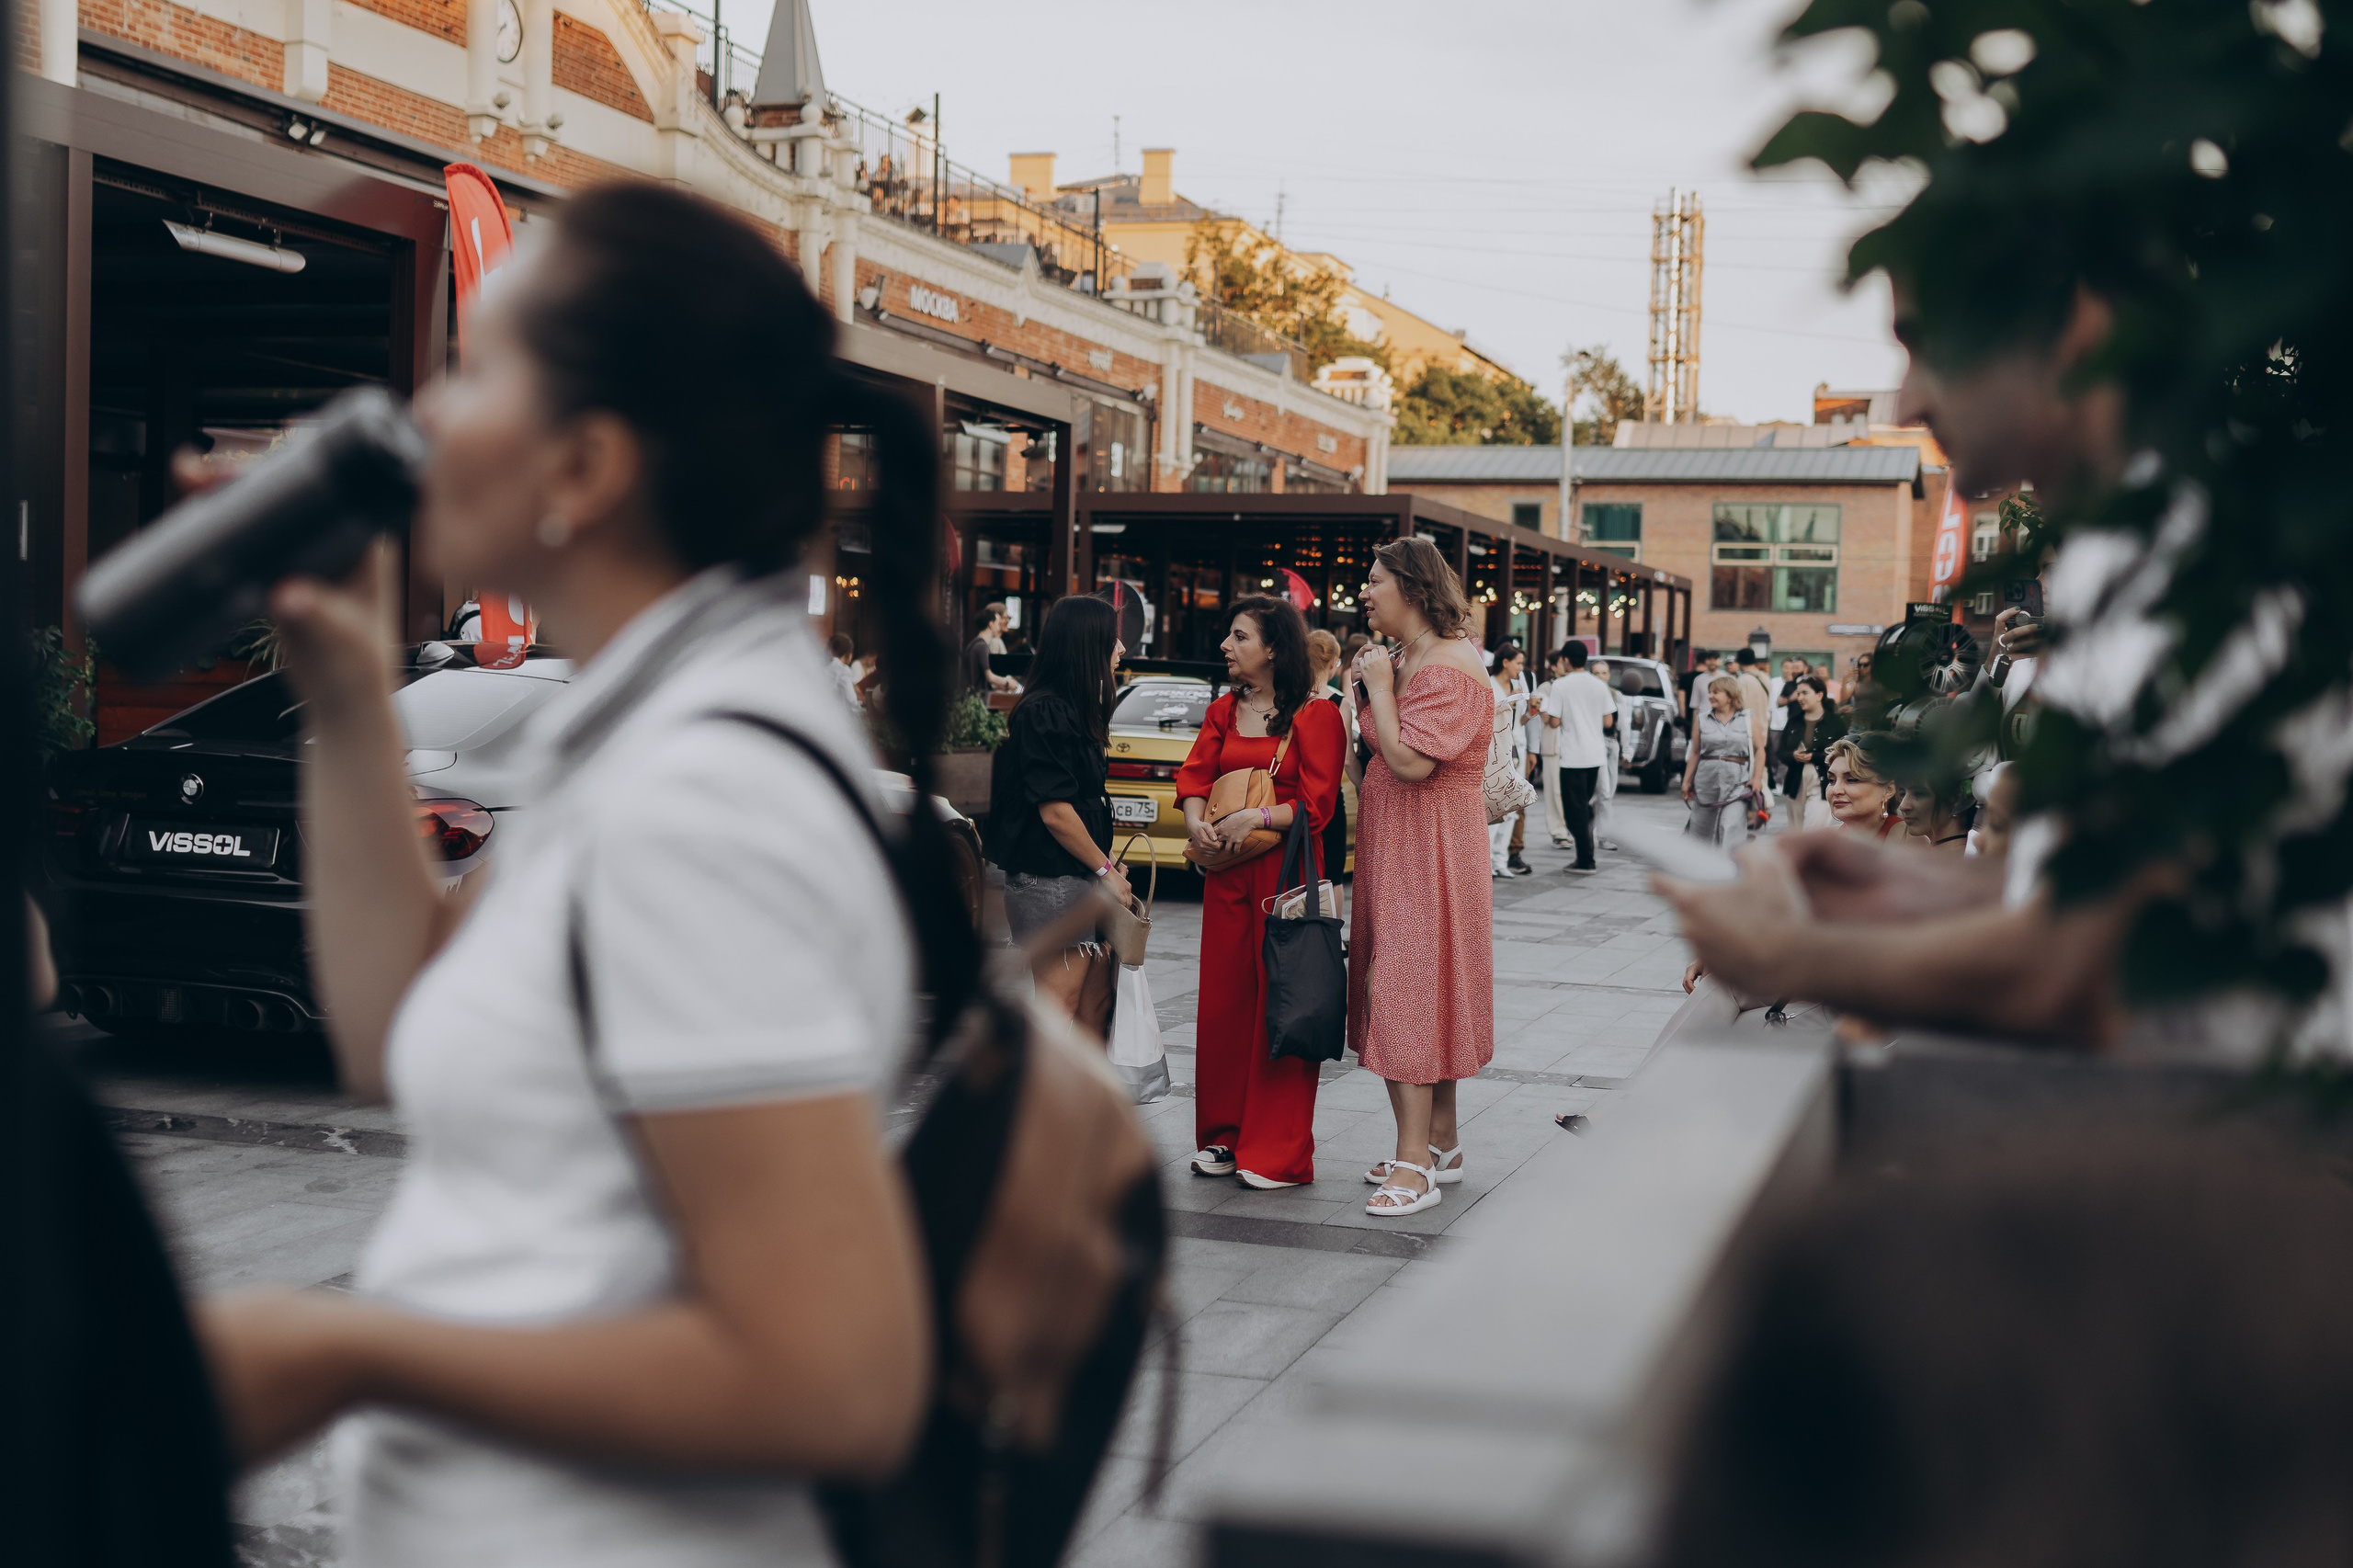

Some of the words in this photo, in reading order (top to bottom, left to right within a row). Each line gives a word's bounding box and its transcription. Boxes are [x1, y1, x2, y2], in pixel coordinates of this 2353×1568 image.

[910, 284, 960, 324] МОСКВА
[1138, 801, 1151, 813] 75
[148, 830, 251, 857] VISSOL
